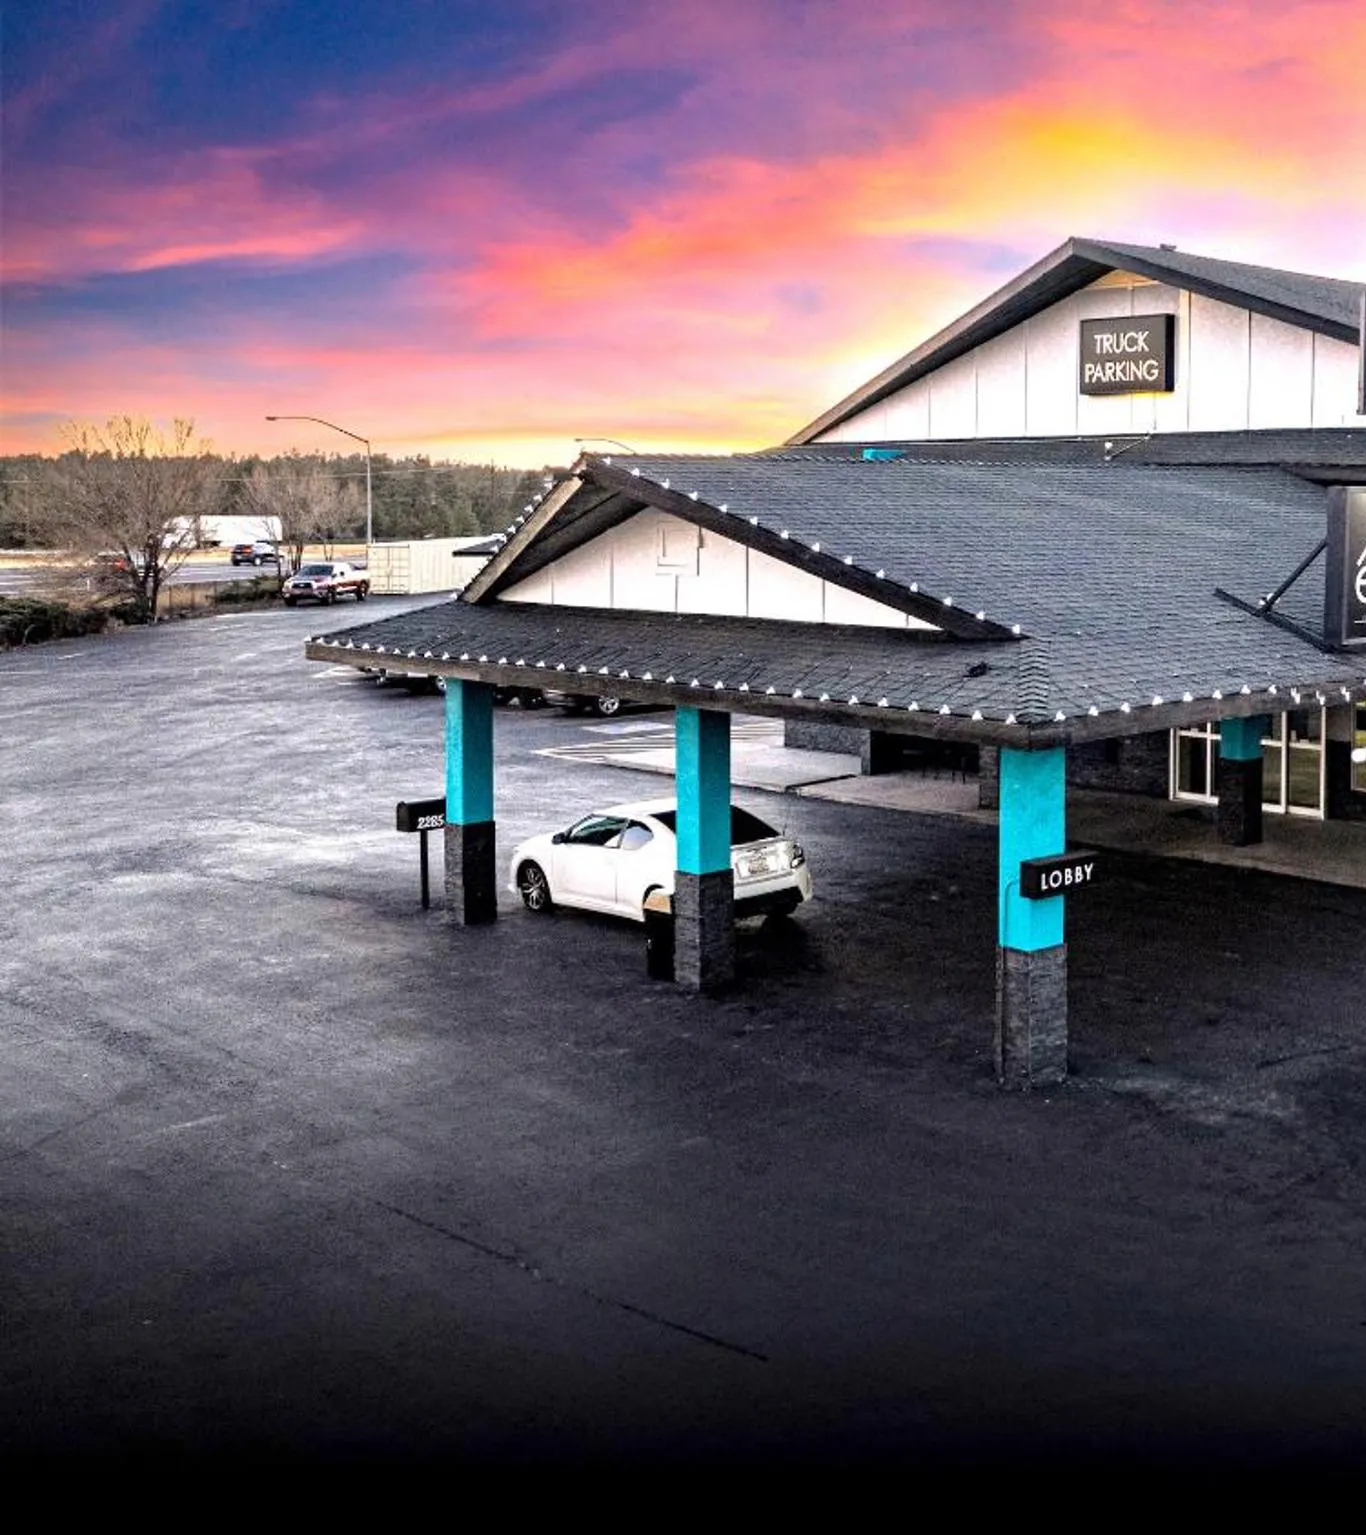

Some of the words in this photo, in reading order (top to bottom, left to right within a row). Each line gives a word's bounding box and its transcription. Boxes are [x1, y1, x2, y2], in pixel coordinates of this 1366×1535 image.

[1094, 331, 1149, 354] TRUCK
[1085, 359, 1159, 383] PARKING
[1041, 862, 1094, 891] LOBBY
